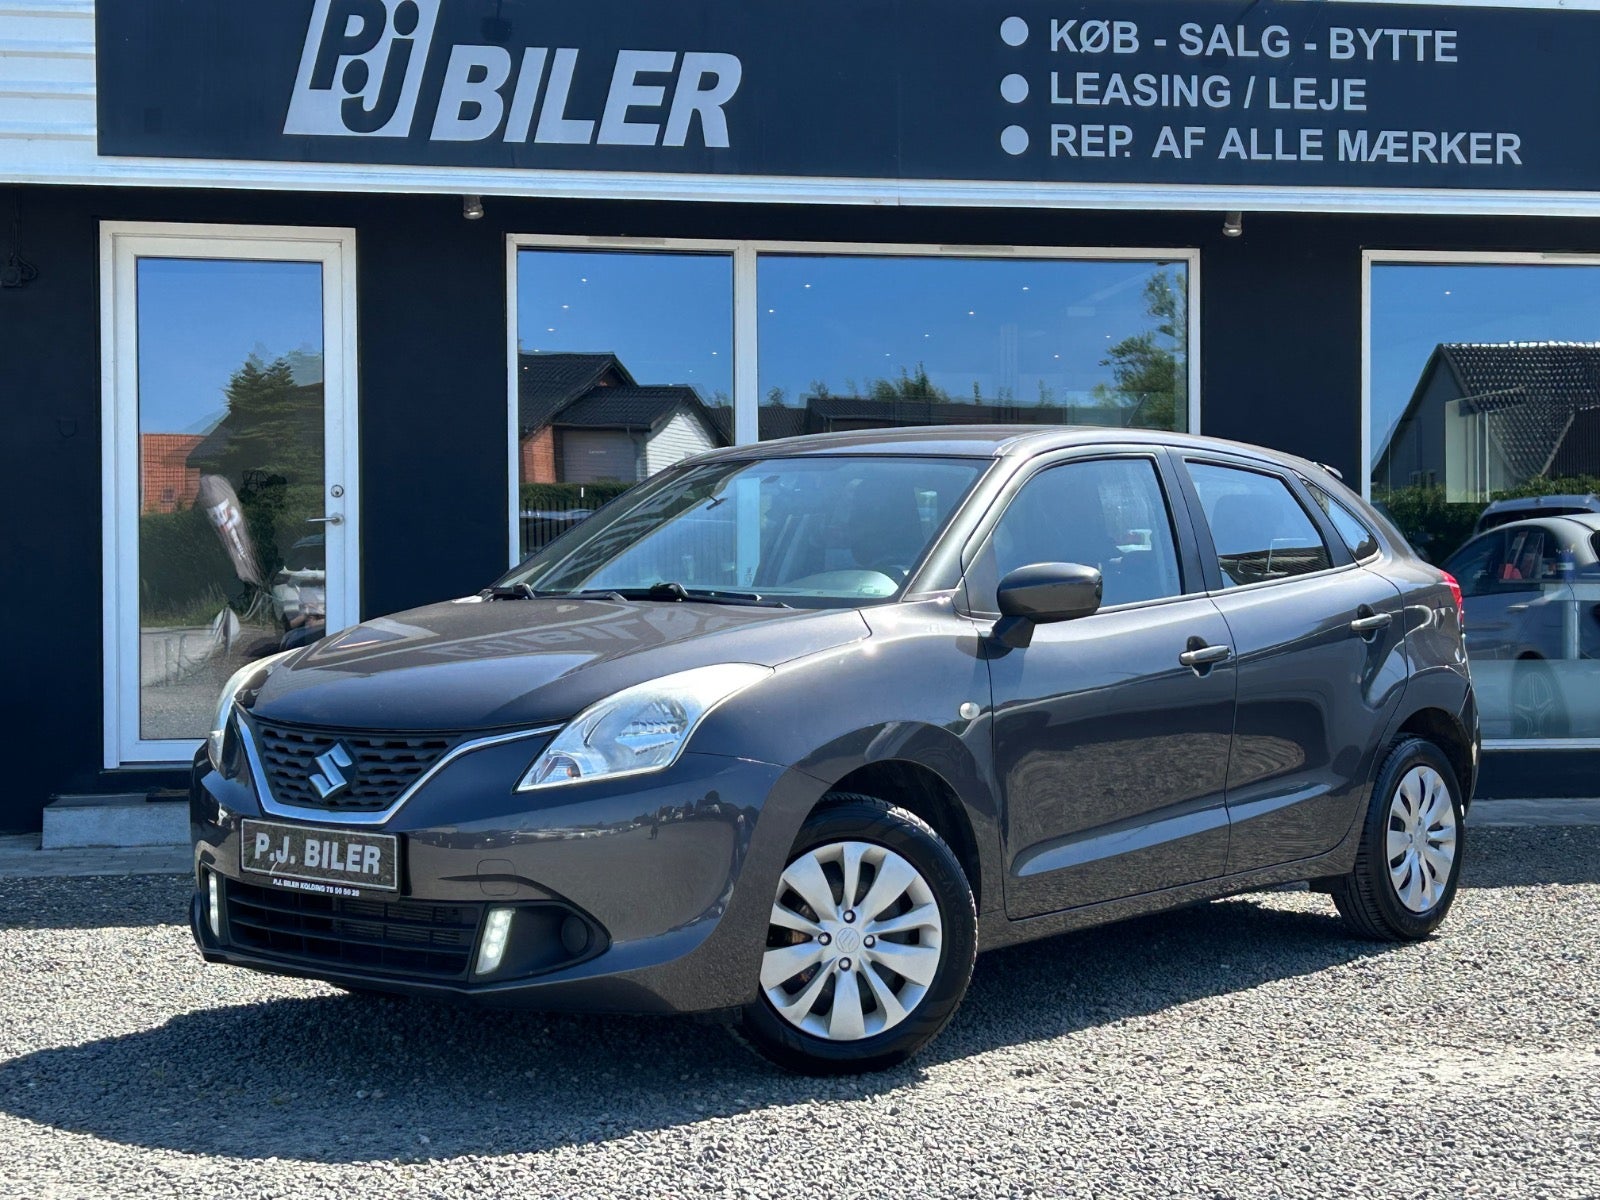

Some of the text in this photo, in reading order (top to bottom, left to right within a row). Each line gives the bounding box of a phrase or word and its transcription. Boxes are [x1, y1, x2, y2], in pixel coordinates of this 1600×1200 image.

[1050, 18, 1140, 54] KØB
[1178, 22, 1291, 58] SALG
[1330, 27, 1459, 63] BYTTE
[429, 44, 743, 148] BILER
[1050, 71, 1367, 112] LEASING / LEJE
[1050, 123, 1523, 165] REP. AF ALLE MÆRKER
[254, 832, 381, 875] P.J. BILER
[300, 882, 326, 893] KOLDING
